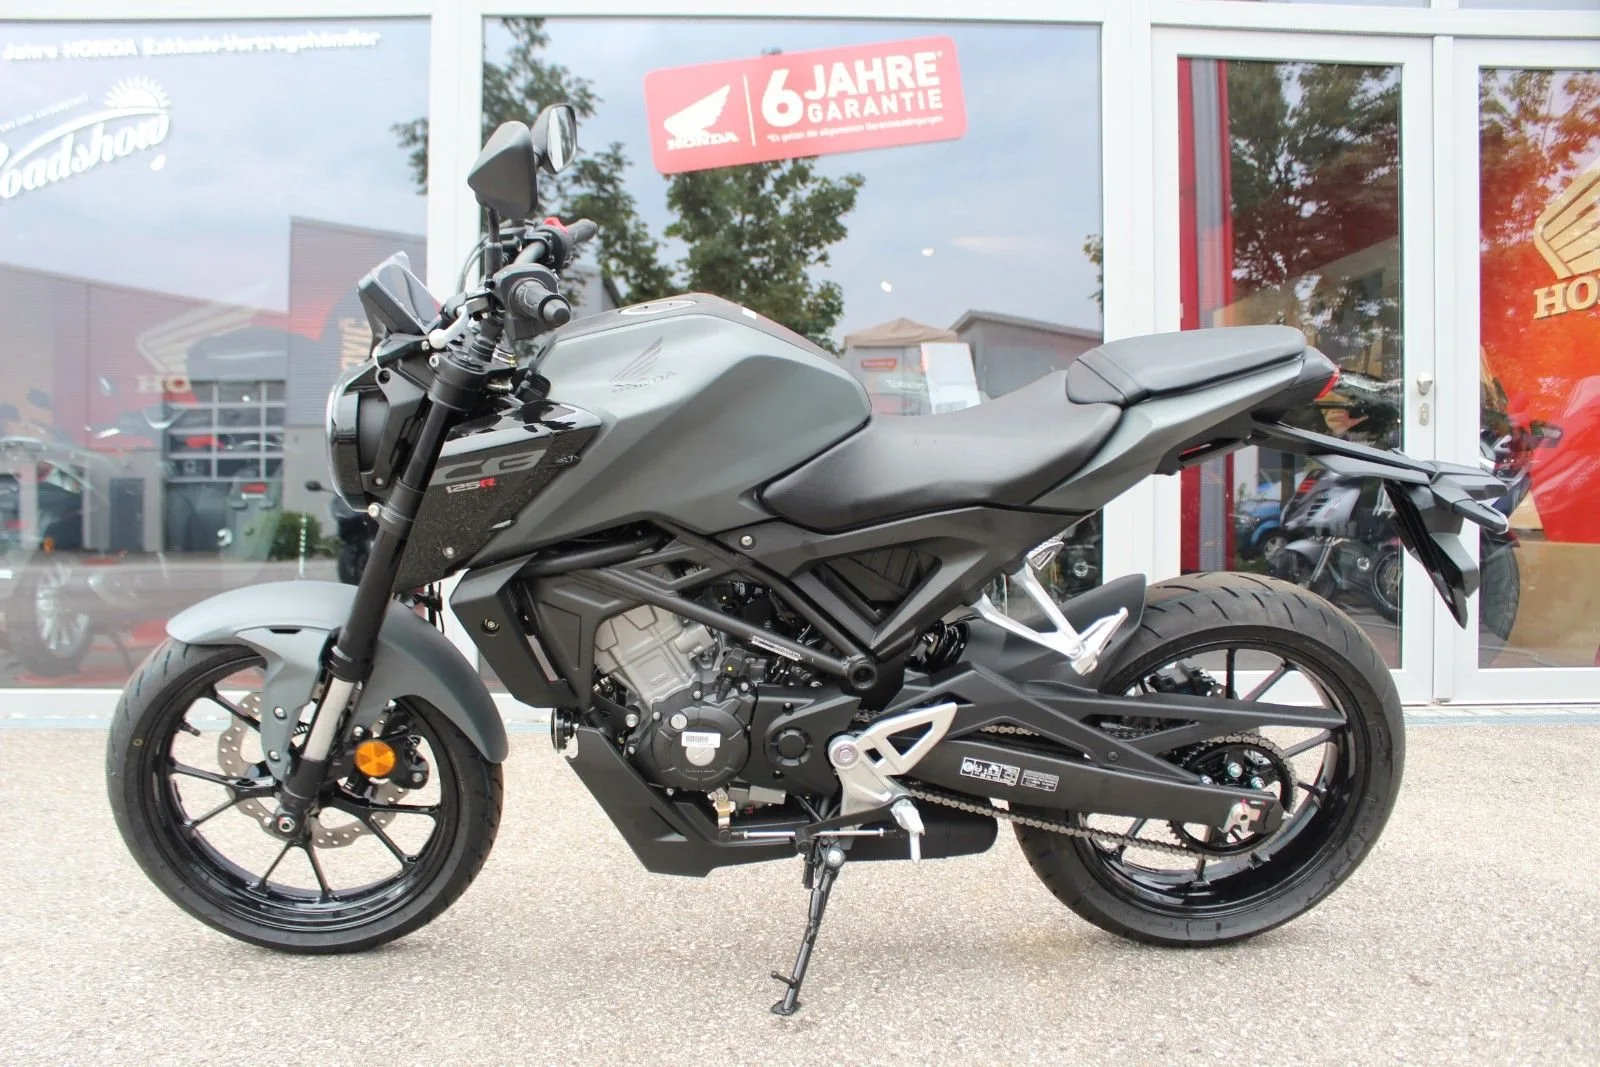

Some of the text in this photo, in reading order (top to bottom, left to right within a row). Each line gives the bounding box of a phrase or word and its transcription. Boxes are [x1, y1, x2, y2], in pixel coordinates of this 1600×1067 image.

[63, 38, 136, 58] HONDA
[762, 69, 804, 127] 6
[807, 88, 943, 123] GARANTIE
[0, 114, 169, 199] oadshow
[665, 131, 739, 151] HONDA
[1534, 274, 1600, 320] HO
[446, 478, 495, 493] 125R
